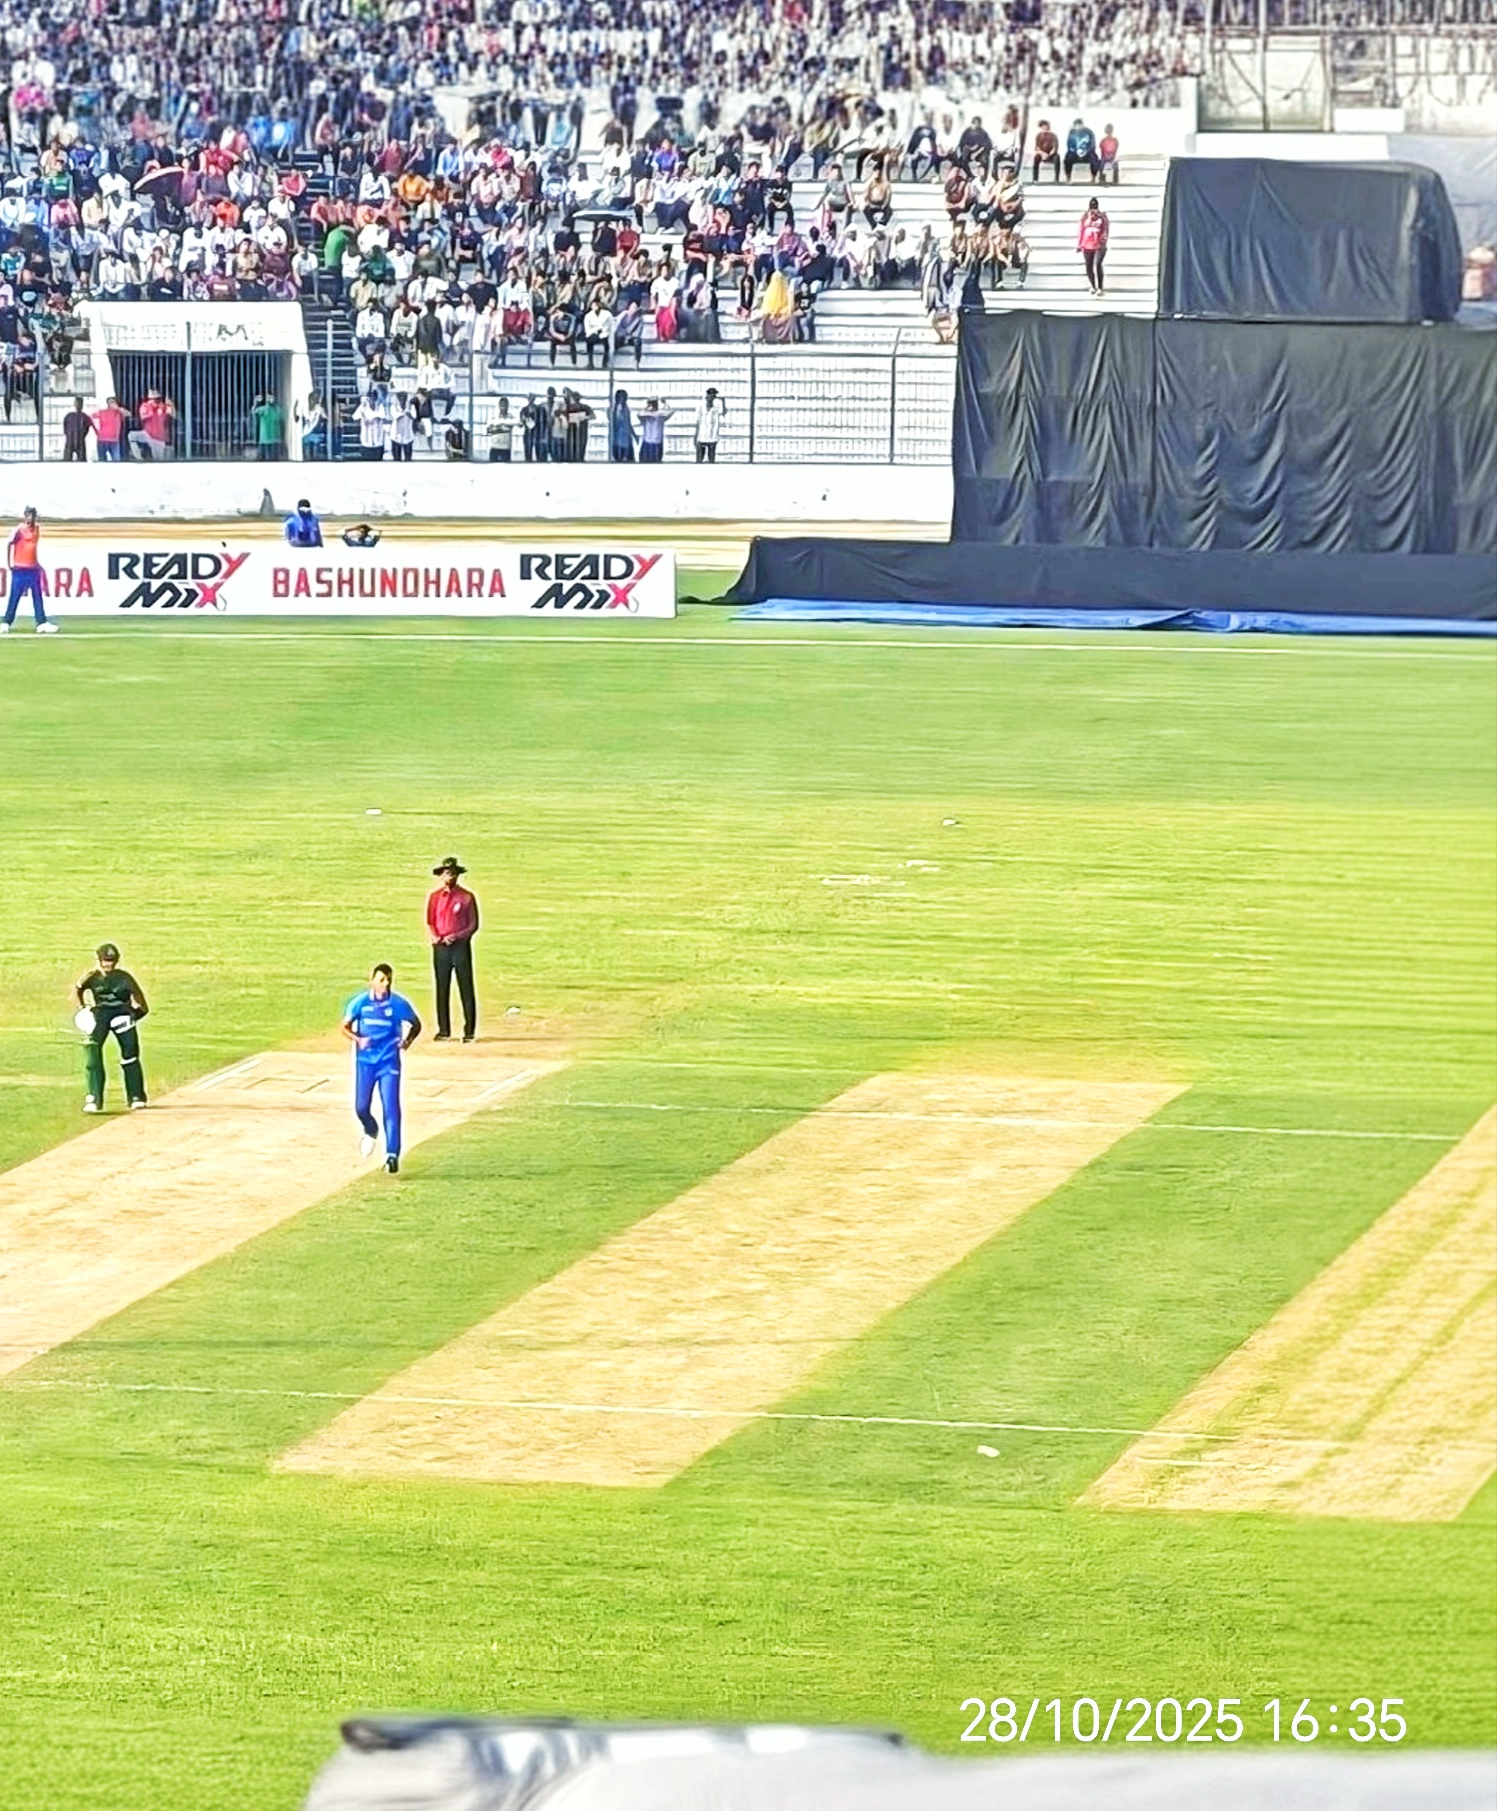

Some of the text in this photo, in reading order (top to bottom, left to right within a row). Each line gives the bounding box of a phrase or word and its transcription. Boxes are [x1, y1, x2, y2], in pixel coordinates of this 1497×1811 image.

[108, 552, 251, 580] READY
[520, 553, 664, 581] READY
[273, 567, 507, 598] BASHUNDHARA
